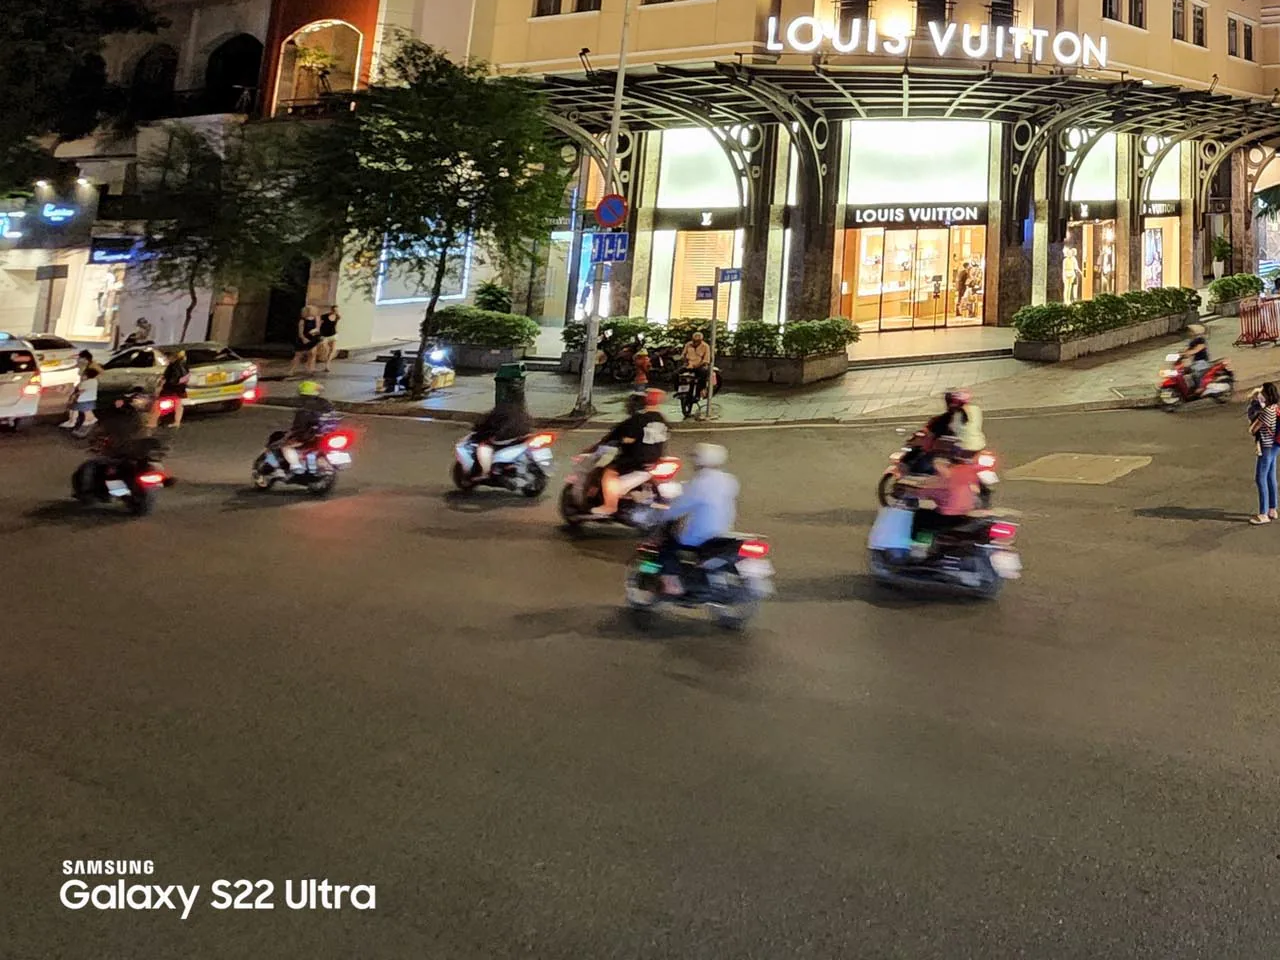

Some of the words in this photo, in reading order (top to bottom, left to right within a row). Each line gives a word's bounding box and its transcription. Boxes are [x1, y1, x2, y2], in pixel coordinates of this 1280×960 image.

[766, 16, 908, 54] LOUIS
[928, 21, 1107, 67] VUITTON
[855, 208, 905, 222] LOUIS
[909, 207, 978, 221] VUITTON
